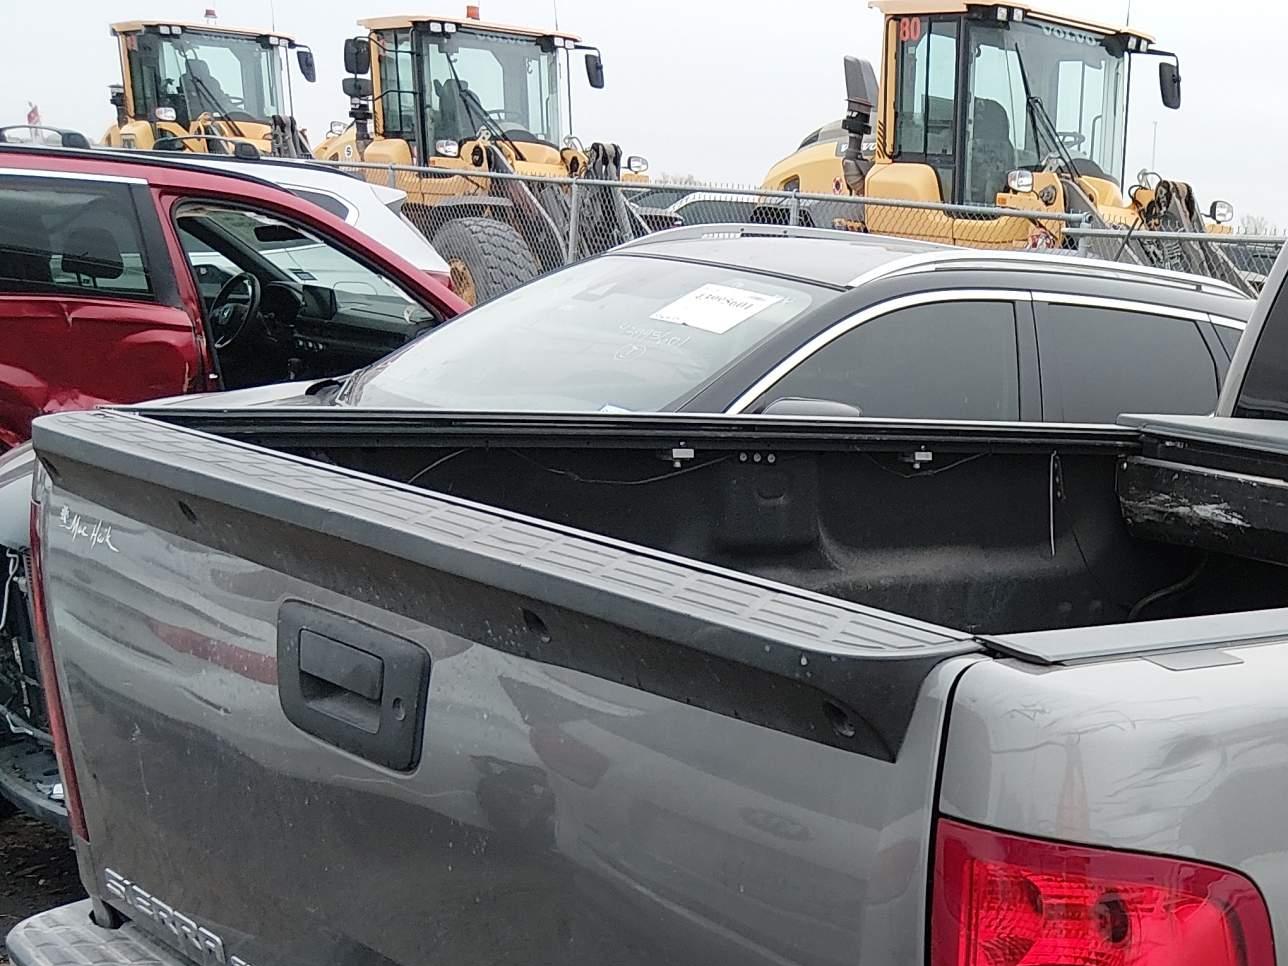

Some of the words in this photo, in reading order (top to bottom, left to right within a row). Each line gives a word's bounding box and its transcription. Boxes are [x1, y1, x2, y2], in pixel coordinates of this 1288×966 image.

[900, 17, 921, 41] 80
[1042, 26, 1097, 46] VOLVO
[105, 867, 226, 965] SIERRA
